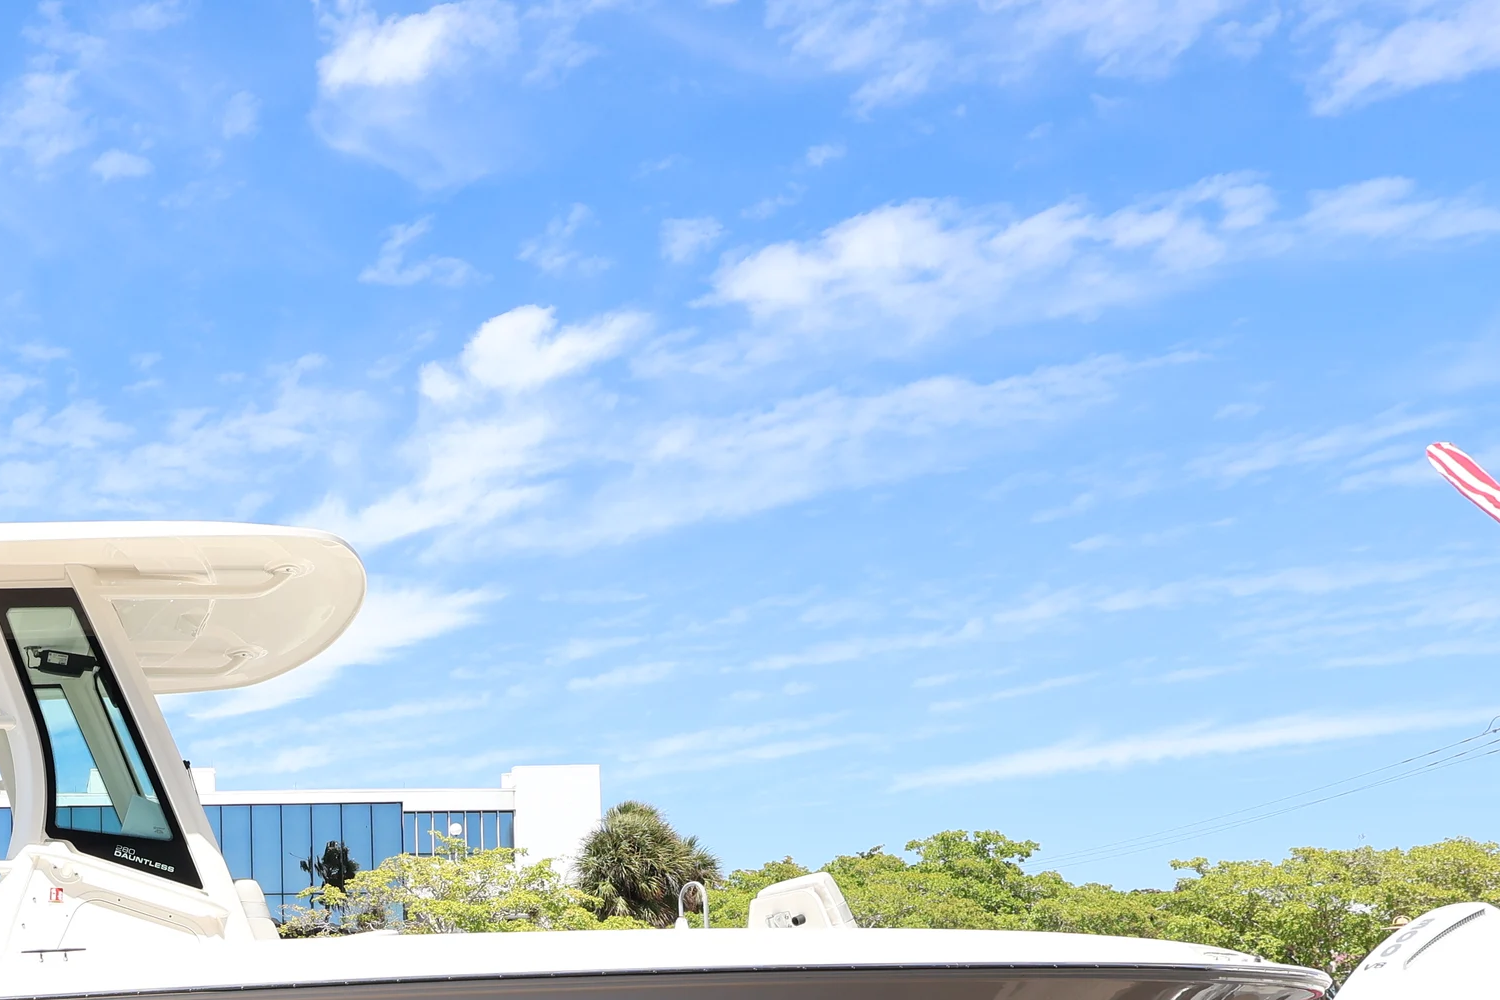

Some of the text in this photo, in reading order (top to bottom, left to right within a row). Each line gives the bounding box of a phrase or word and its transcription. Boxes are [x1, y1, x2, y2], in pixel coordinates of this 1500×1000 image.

[115, 844, 136, 855] 280
[113, 850, 175, 873] DAUNTLESS
[1379, 918, 1436, 958] 300
